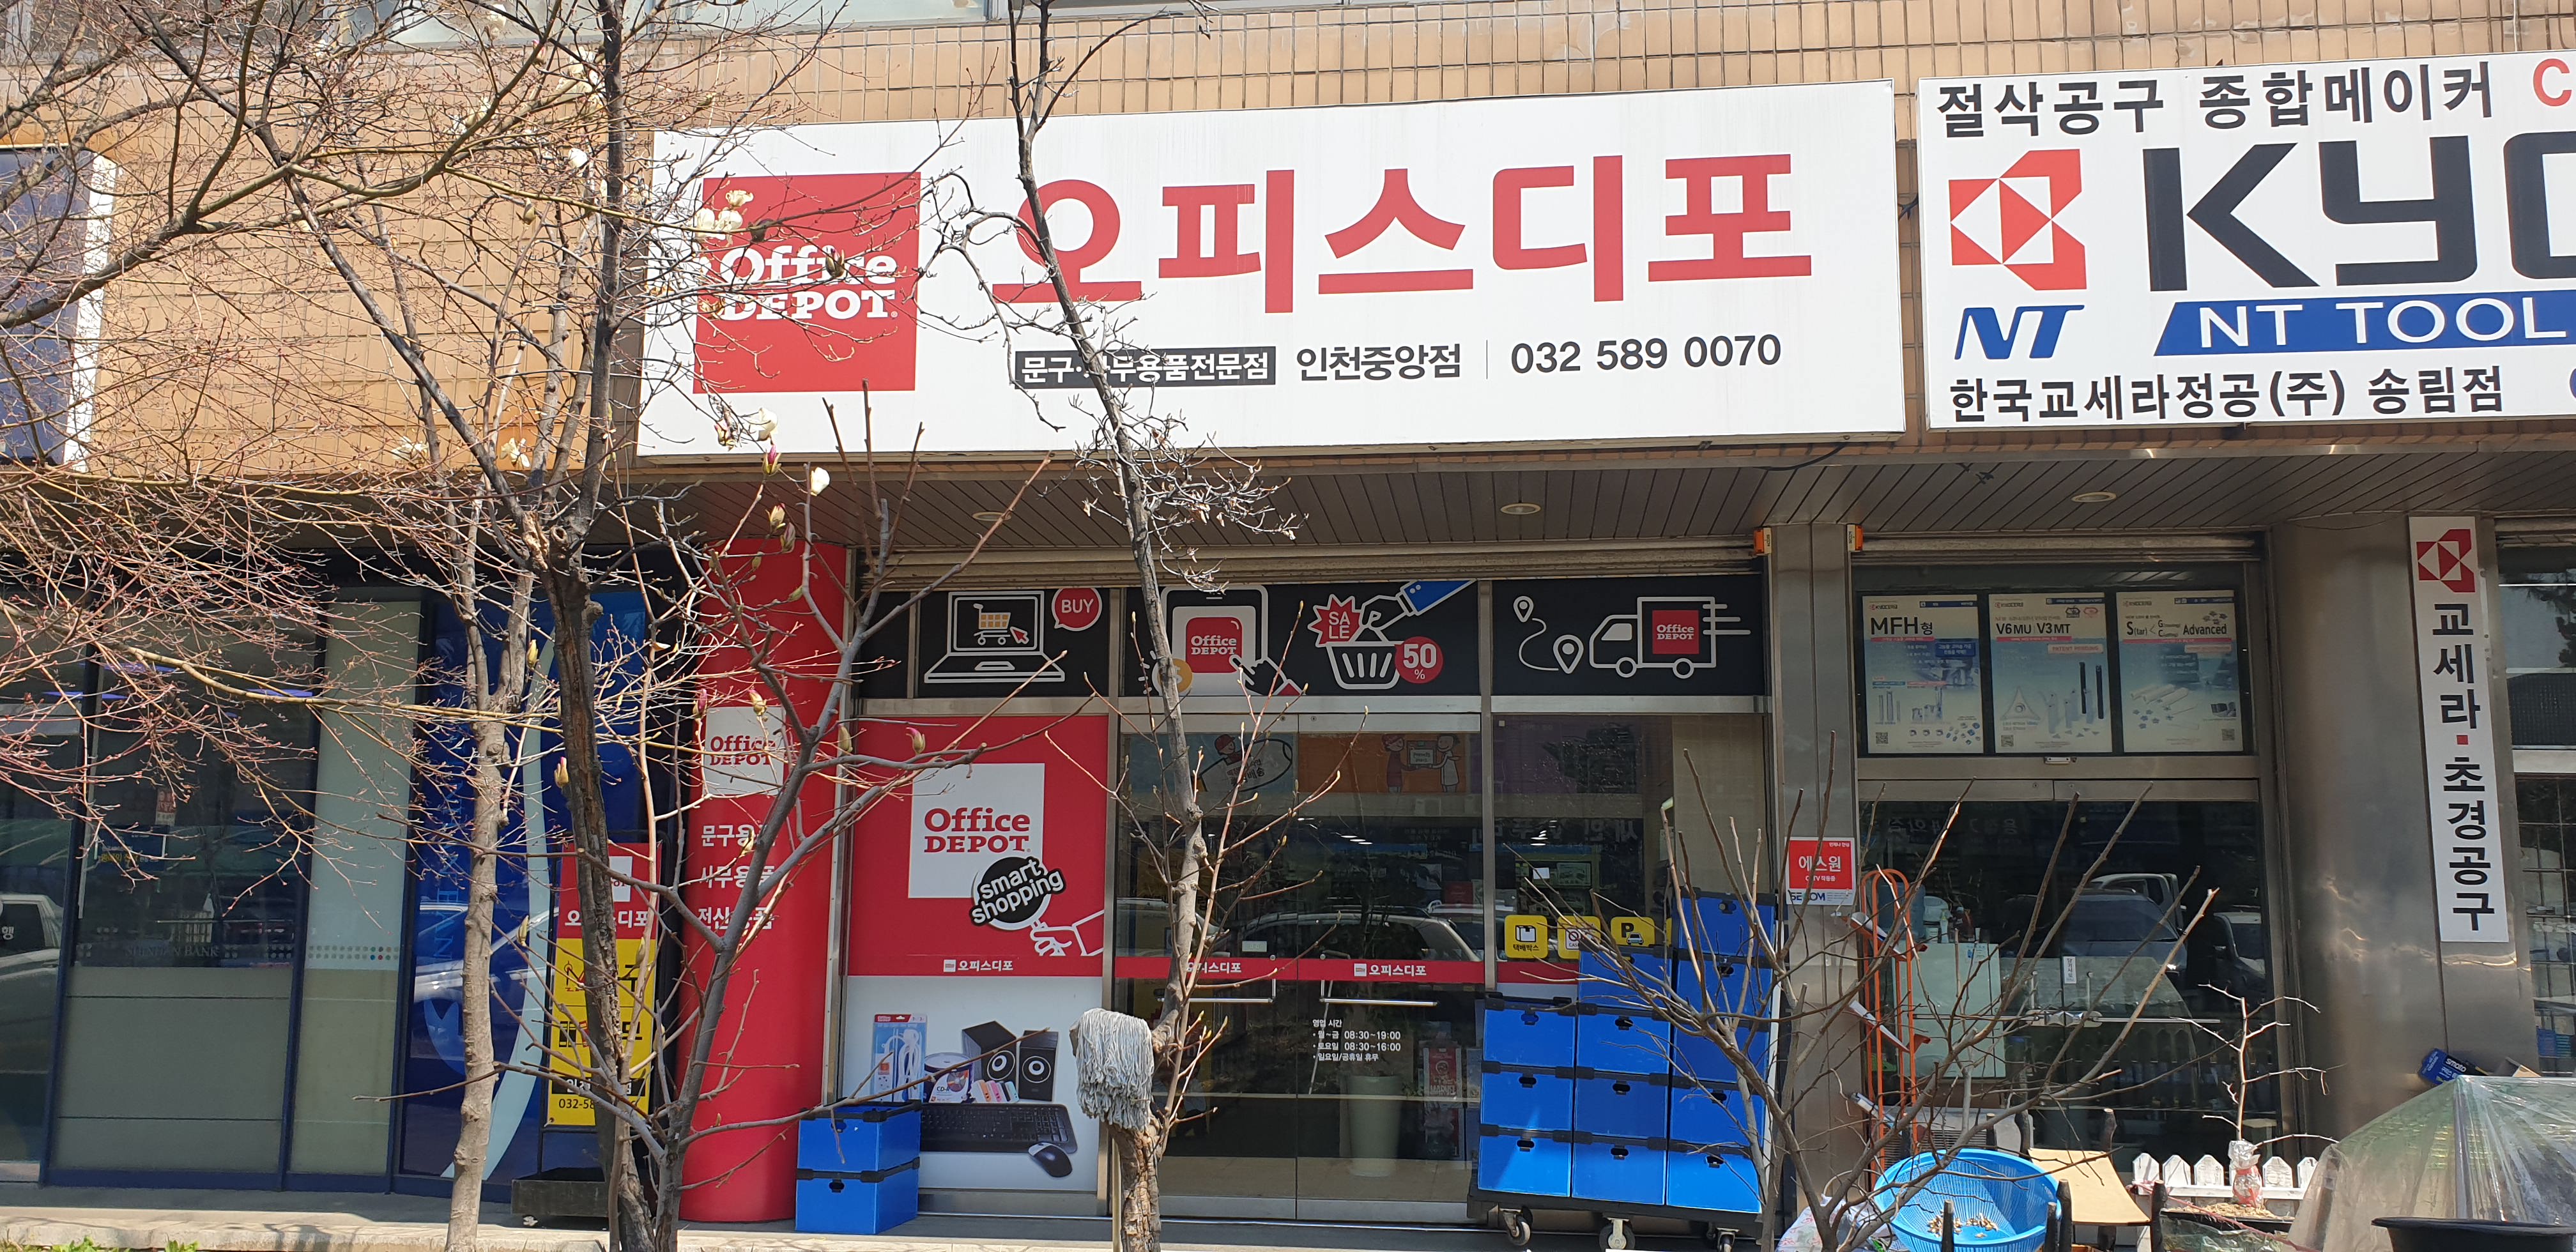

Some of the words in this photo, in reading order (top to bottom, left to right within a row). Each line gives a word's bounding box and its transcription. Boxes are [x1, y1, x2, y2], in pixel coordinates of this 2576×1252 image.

[1936, 79, 2165, 137] 절삭공구
[2199, 61, 2491, 128] 종합메이커
[993, 153, 1811, 314] 오피스디포
[720, 289, 895, 321] DEPOT
[2199, 303, 2303, 347] NT
[2335, 297, 2566, 344] TOOL
[1954, 304, 2085, 360] NT
[1022, 351, 1268, 383] 문구·무용품전문점
[1296, 342, 1460, 382] 인천중앙점
[1510, 342, 1581, 374] 032
[1596, 338, 1667, 370] 589
[1683, 334, 1781, 368] 0070
[1949, 369, 2345, 422] 한국교세라정공(주)
[2368, 364, 2503, 415] 송림점
[1061, 599, 1094, 613] BUY
[1656, 623, 1694, 634] Office
[2183, 623, 2227, 635] Advanced
[1190, 634, 1238, 647] Office
[1190, 646, 1237, 655] DEPOT
[1403, 644, 1437, 669] 50
[710, 735, 776, 752] Office
[924, 807, 1030, 832] Office
[702, 824, 776, 847] 문구용
[924, 835, 1029, 853] DEPOT
[1798, 856, 1841, 872] 에스원
[980, 859, 1041, 899] smart
[972, 871, 1064, 923] shopping
[1790, 892, 1825, 901] SEOM
[565, 910, 648, 928] 오디포
[698, 906, 772, 929] 전산품
[1513, 943, 1539, 952] 택배박스
[958, 960, 1013, 972] 오피스디포
[1369, 964, 1427, 977] 오피스디포
[1312, 1019, 1326, 1027] 영업
[1328, 1019, 1342, 1027] 시간
[1344, 1031, 1401, 1040] 08:30~19:00
[1344, 1042, 1401, 1051] 08:30~16:00
